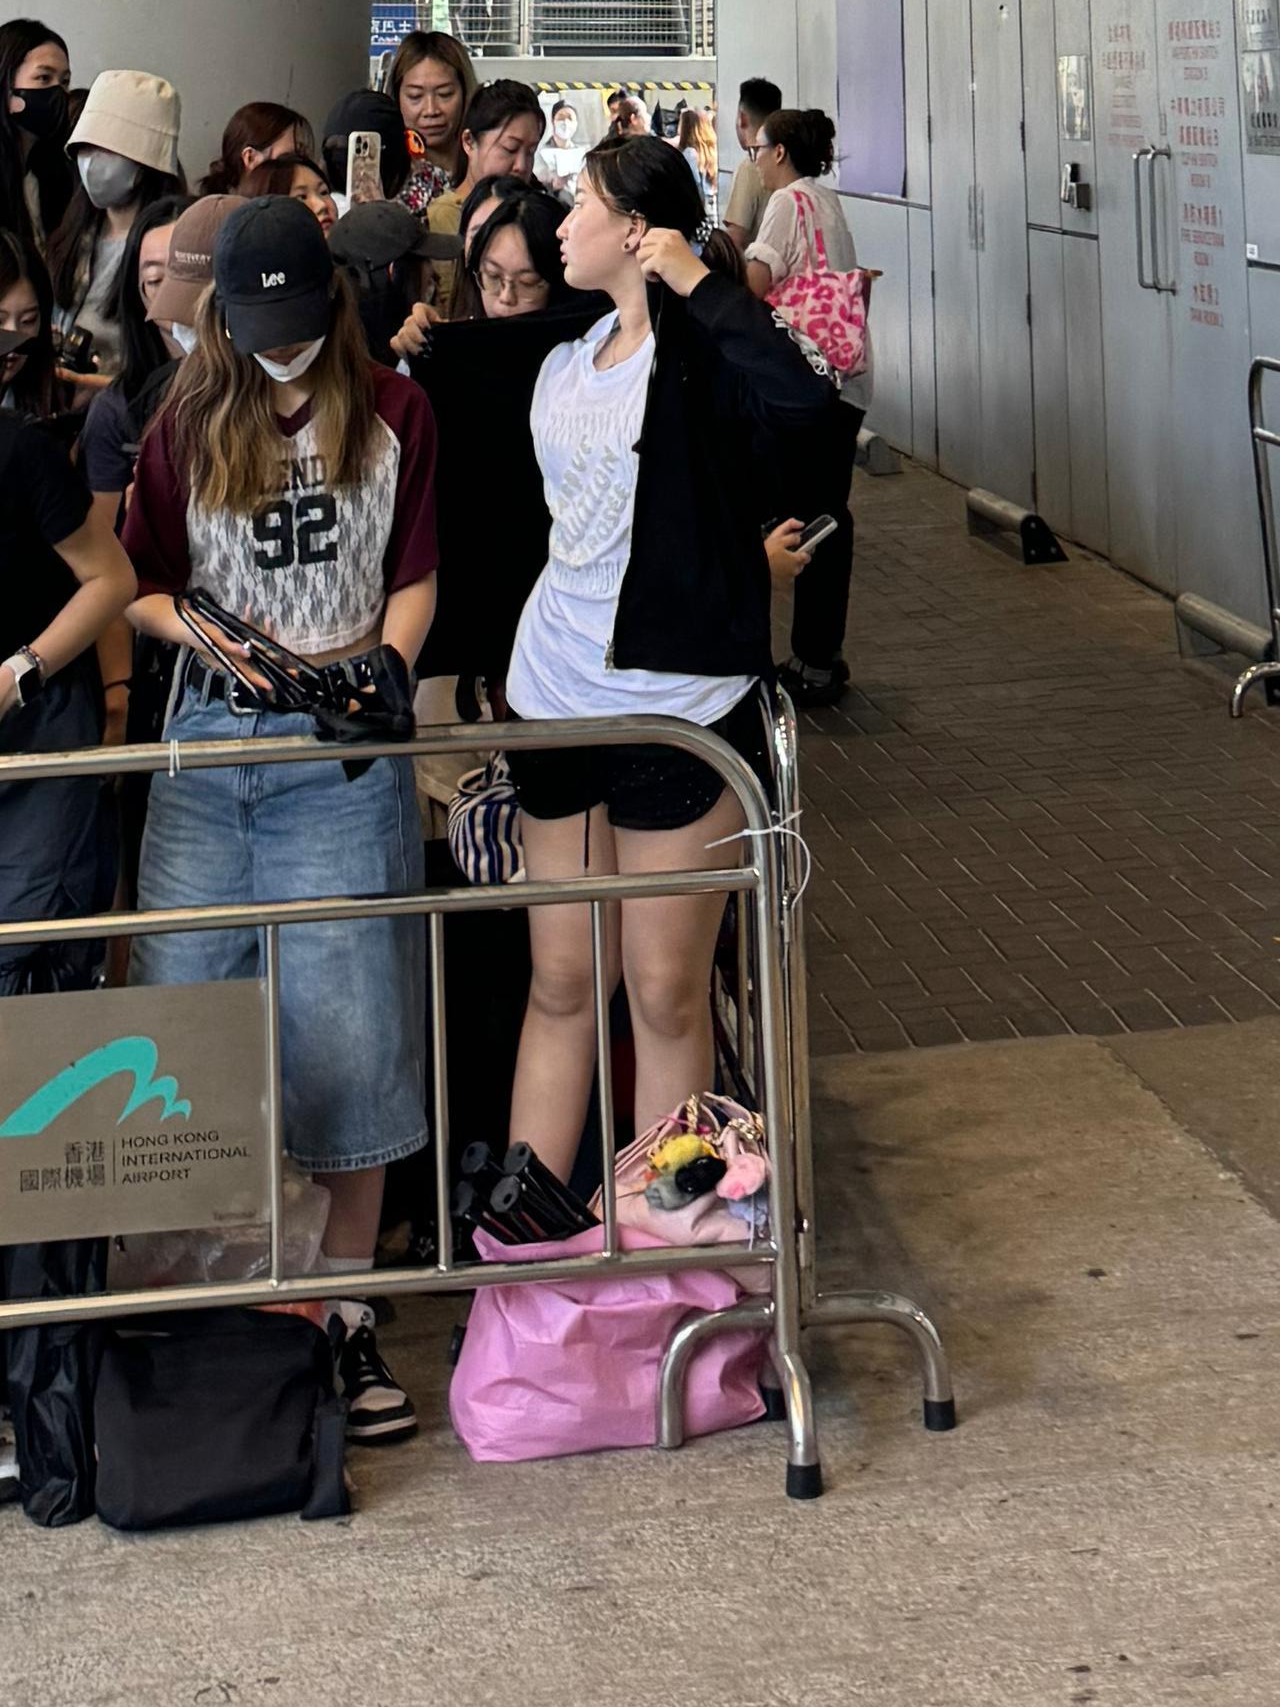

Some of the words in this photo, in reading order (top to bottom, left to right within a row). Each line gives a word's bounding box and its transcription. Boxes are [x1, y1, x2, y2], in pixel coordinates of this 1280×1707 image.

[261, 271, 286, 288] Lee
[252, 493, 338, 570] 92
[121, 1132, 170, 1149] HONG
[173, 1130, 220, 1145] KONG
[64, 1140, 105, 1165] 香港
[121, 1146, 251, 1167] INTERNATIONAL
[19, 1163, 106, 1193] 國際機場
[121, 1168, 192, 1185] AIRPORT
